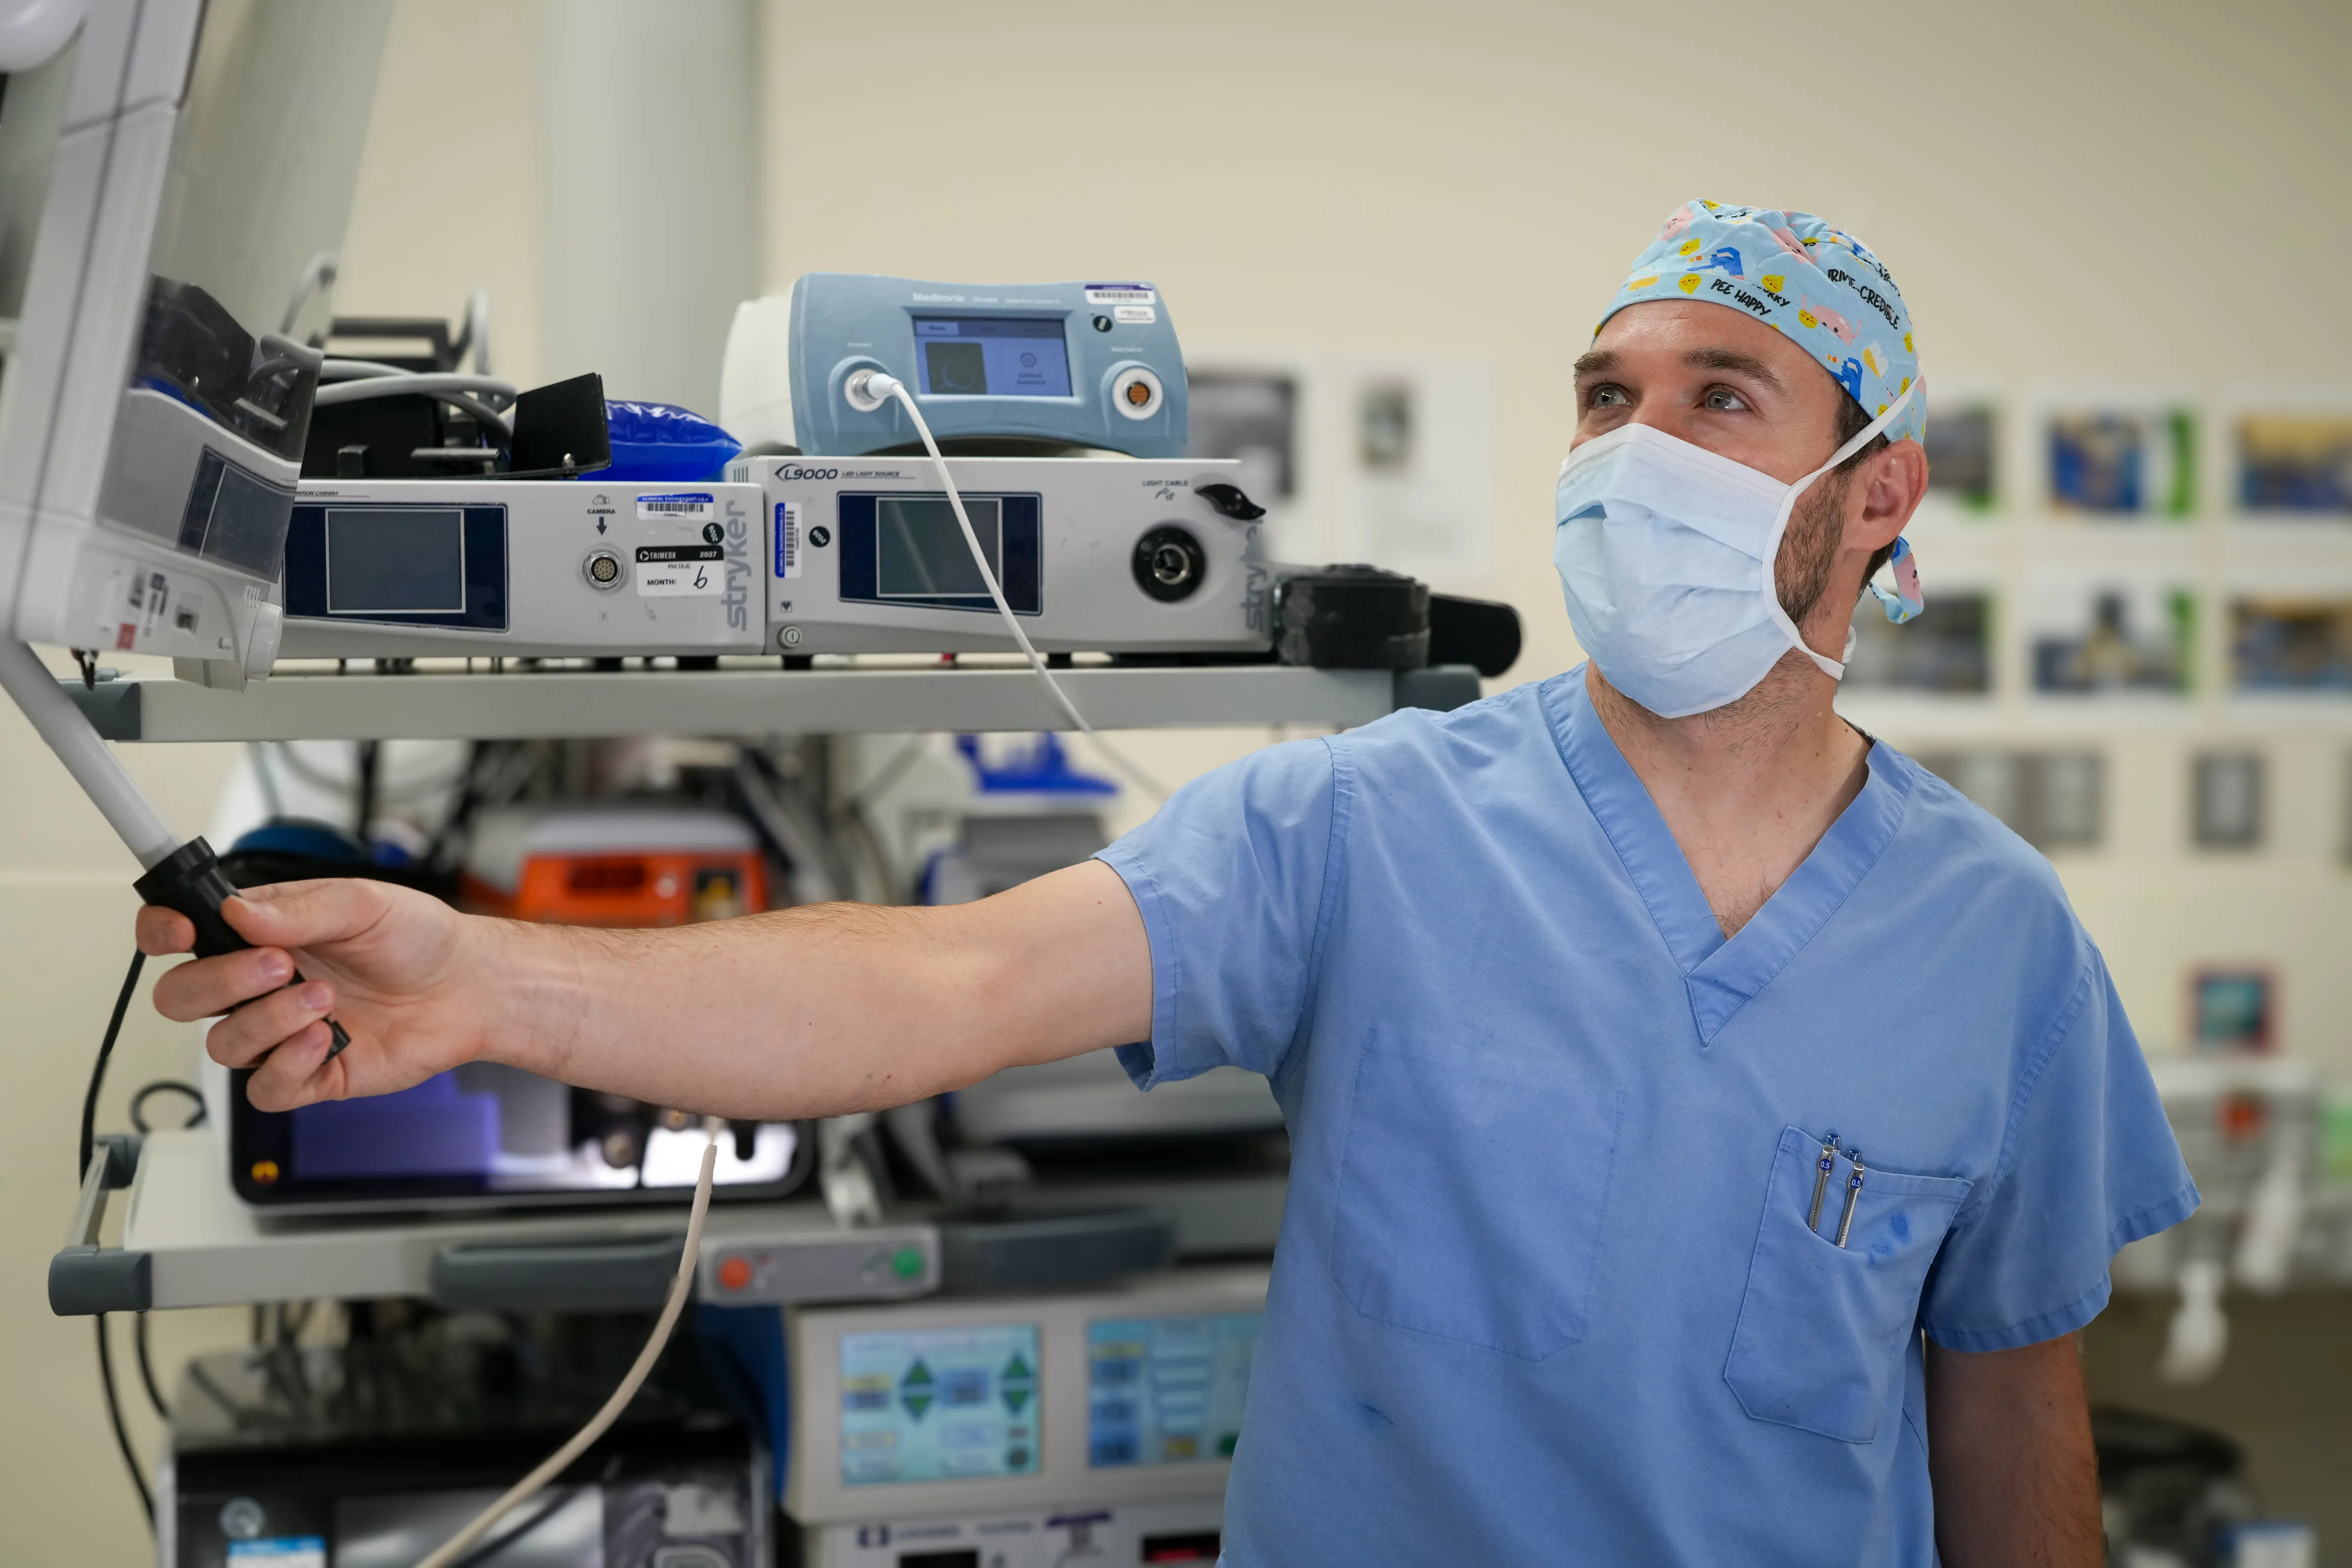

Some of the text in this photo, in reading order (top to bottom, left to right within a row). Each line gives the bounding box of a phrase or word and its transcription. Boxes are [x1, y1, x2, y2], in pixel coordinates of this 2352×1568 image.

[1710, 278, 1772, 316] PEE HAPPY
[784, 468, 838, 480] L9000
[650, 551, 677, 560] TRIMEDX
[721, 500, 752, 632] stryker
[693, 565, 708, 589] 6
[1820, 1161, 1830, 1169] 0.5
